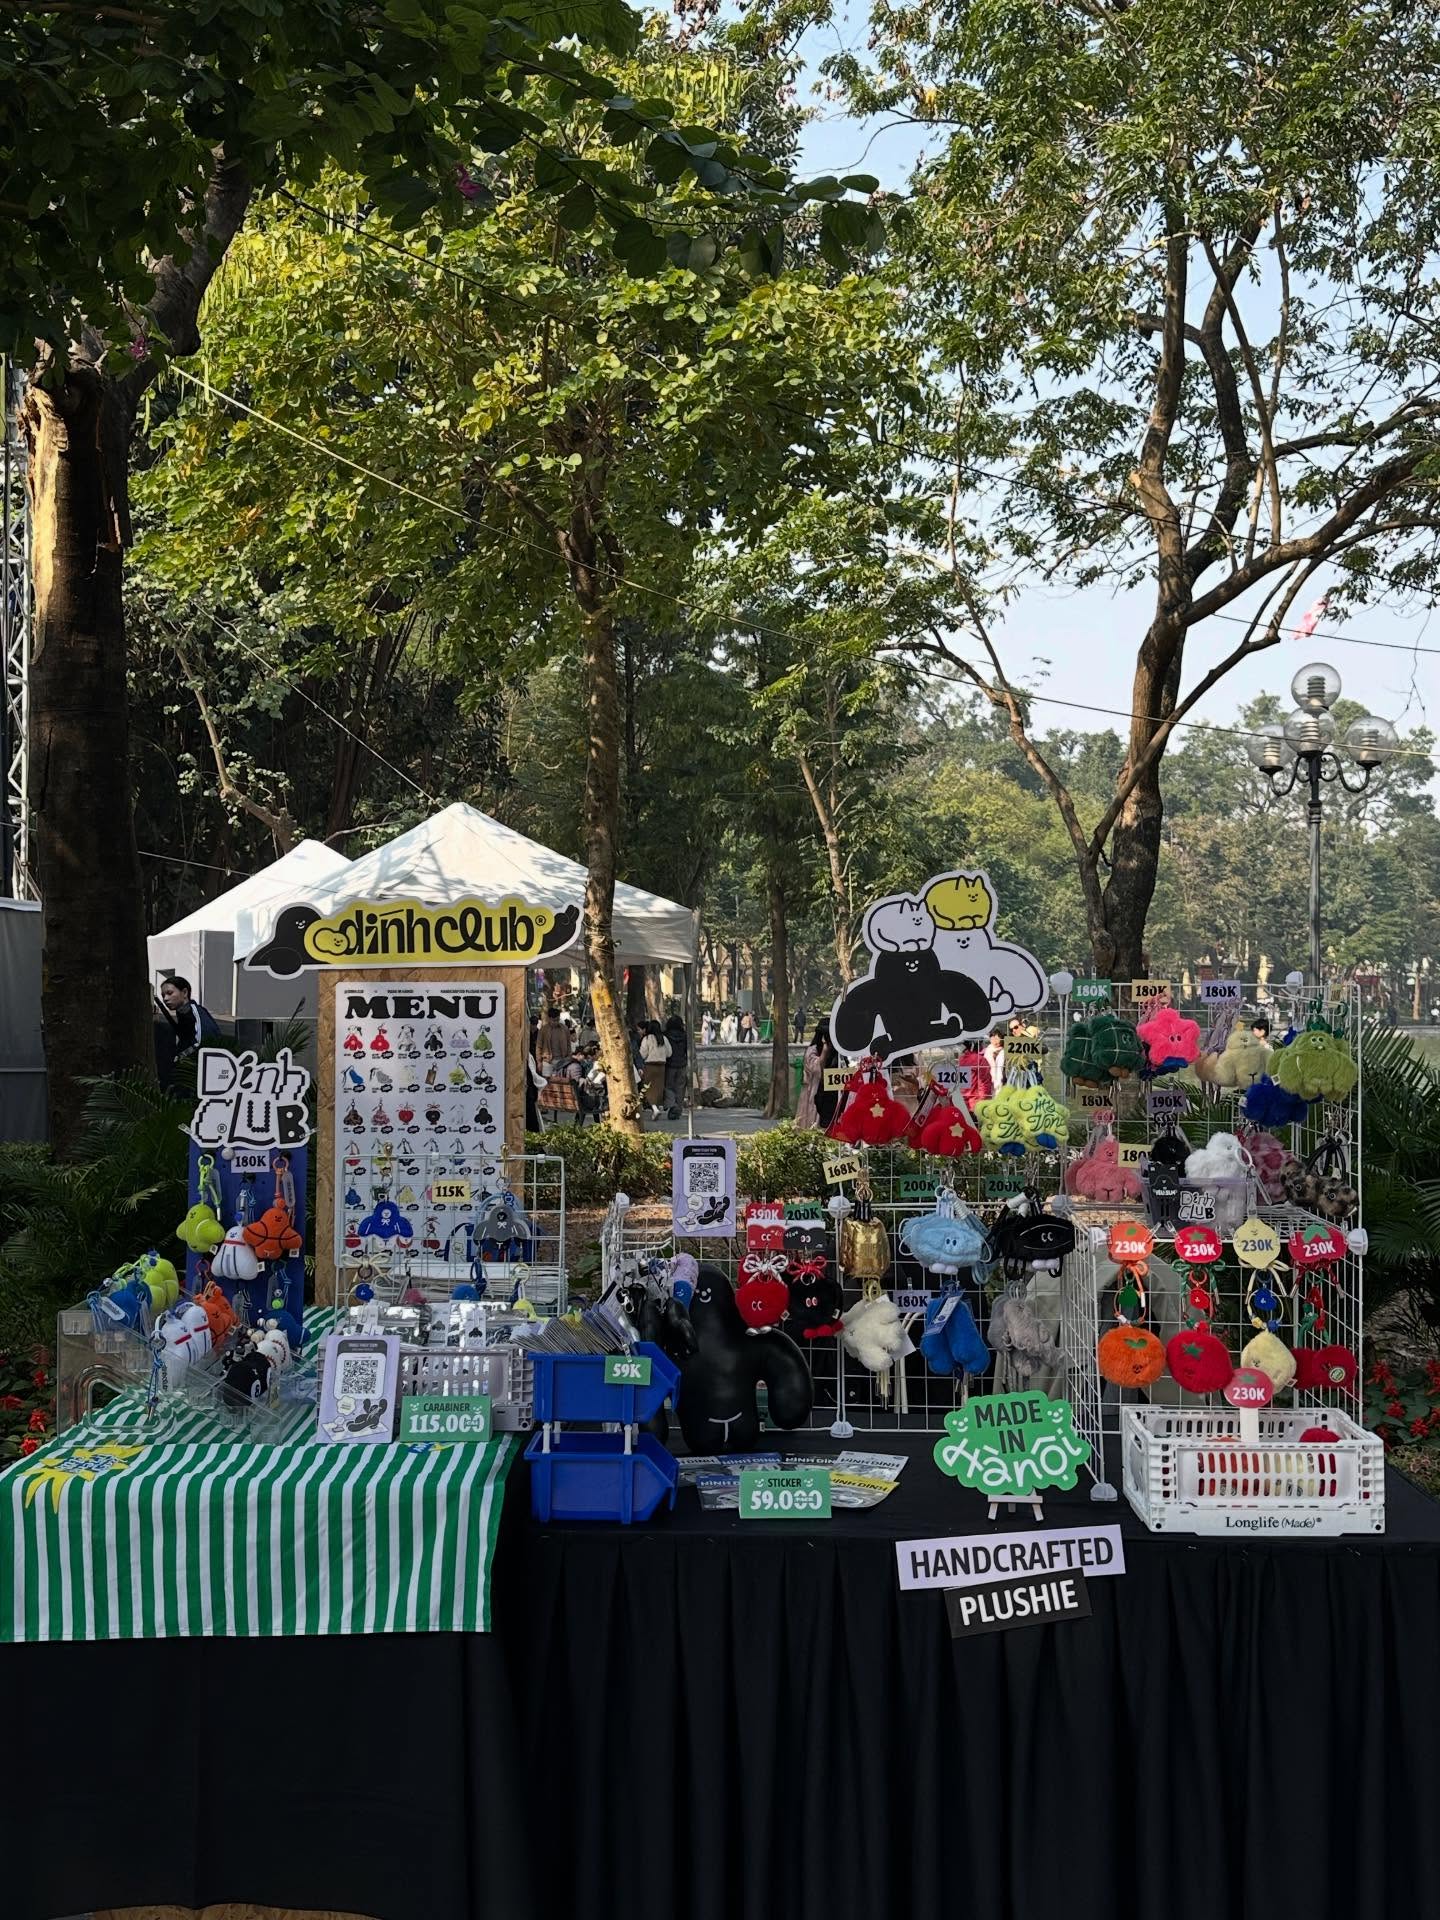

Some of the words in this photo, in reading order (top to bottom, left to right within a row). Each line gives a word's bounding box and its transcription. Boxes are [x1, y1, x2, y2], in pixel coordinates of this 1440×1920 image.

[1076, 985, 1107, 996] 180K
[1136, 986, 1167, 996] 180K
[1206, 986, 1237, 997] 180K
[345, 996, 499, 1019] MENU
[1008, 1042, 1040, 1054] 220K
[938, 1072, 968, 1083] 120K
[1082, 1095, 1113, 1106] 180K
[1152, 1096, 1183, 1108] 190K
[236, 1156, 266, 1167] 180K
[1122, 1150, 1152, 1161] 180
[829, 1162, 858, 1178] 168K
[436, 1186, 465, 1197] 115K
[904, 1180, 936, 1191] 200K
[989, 1180, 1024, 1192] 200K
[750, 1208, 779, 1220] 390K
[787, 1206, 820, 1220] 200K
[1115, 1241, 1146, 1254] 230K
[1183, 1244, 1216, 1257] 230K
[1242, 1239, 1273, 1251] 230K
[1303, 1241, 1336, 1257] 230K
[897, 1295, 927, 1307] 180K
[612, 1363, 641, 1378] 59K
[1232, 1387, 1265, 1400] 230K
[424, 1403, 470, 1412] CARABINER
[974, 1400, 1043, 1428] MADE
[409, 1414, 485, 1433] 115.000
[999, 1429, 1026, 1453] IN
[767, 1478, 801, 1488] STICKER
[750, 1490, 822, 1510] 59.000
[1225, 1516, 1280, 1531] Longlife
[910, 1537, 1113, 1579] HANDCRAFTED
[959, 1579, 1079, 1626] PLUSHIE
